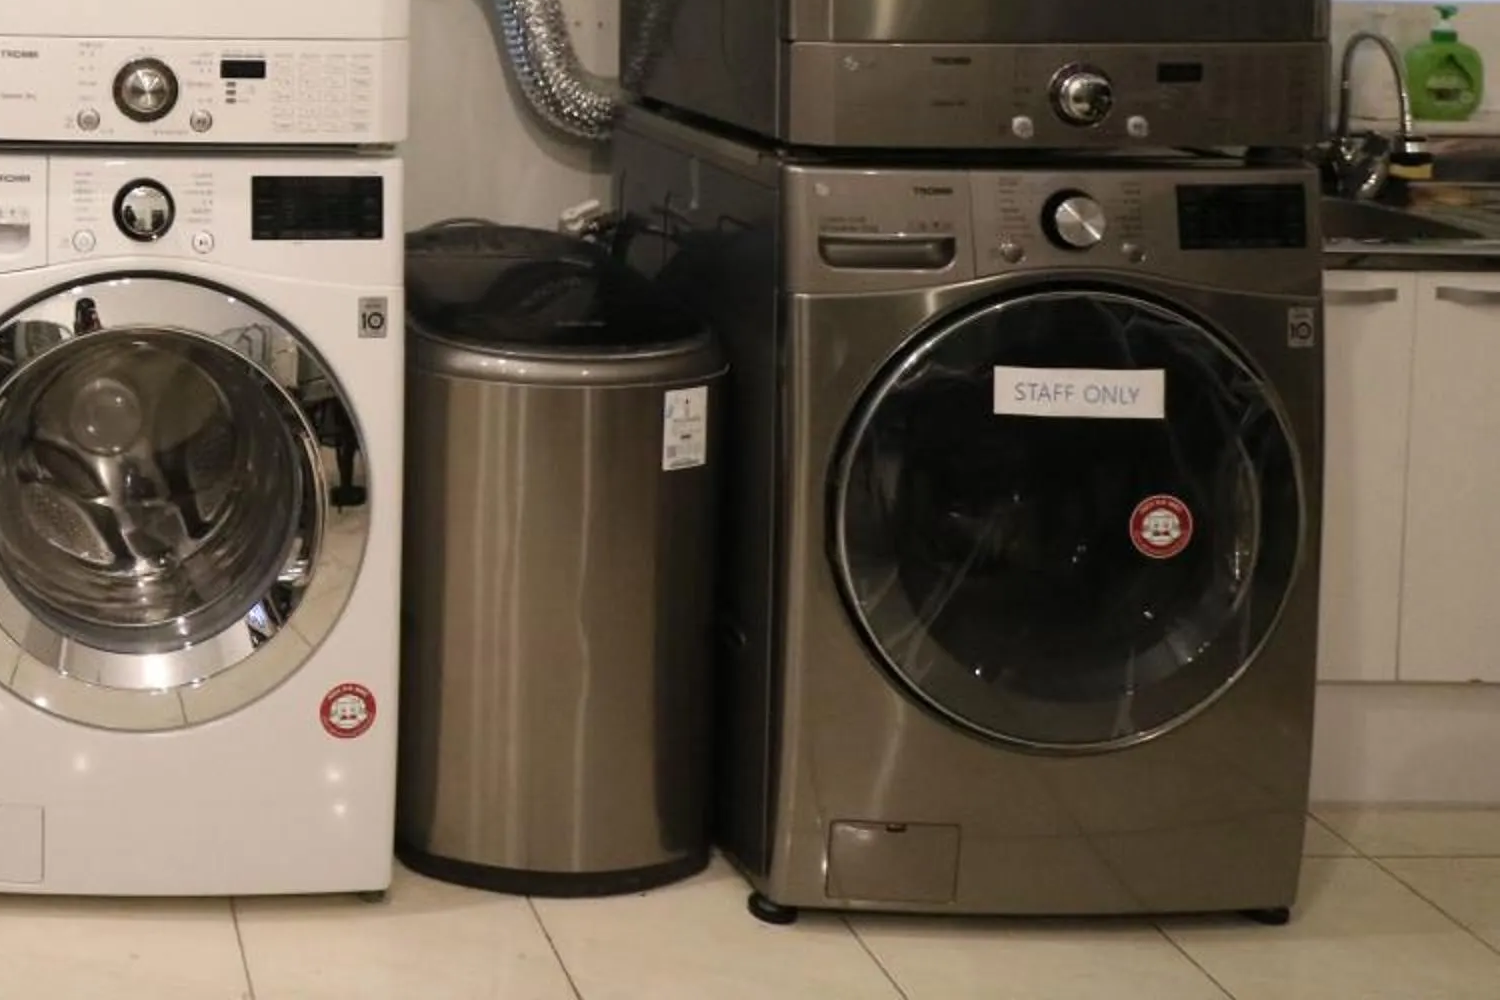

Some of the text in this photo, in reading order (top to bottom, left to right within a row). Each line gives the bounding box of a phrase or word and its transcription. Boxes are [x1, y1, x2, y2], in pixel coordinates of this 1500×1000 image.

[361, 311, 385, 331] 10
[1013, 382, 1141, 405] STAFF ONLY
